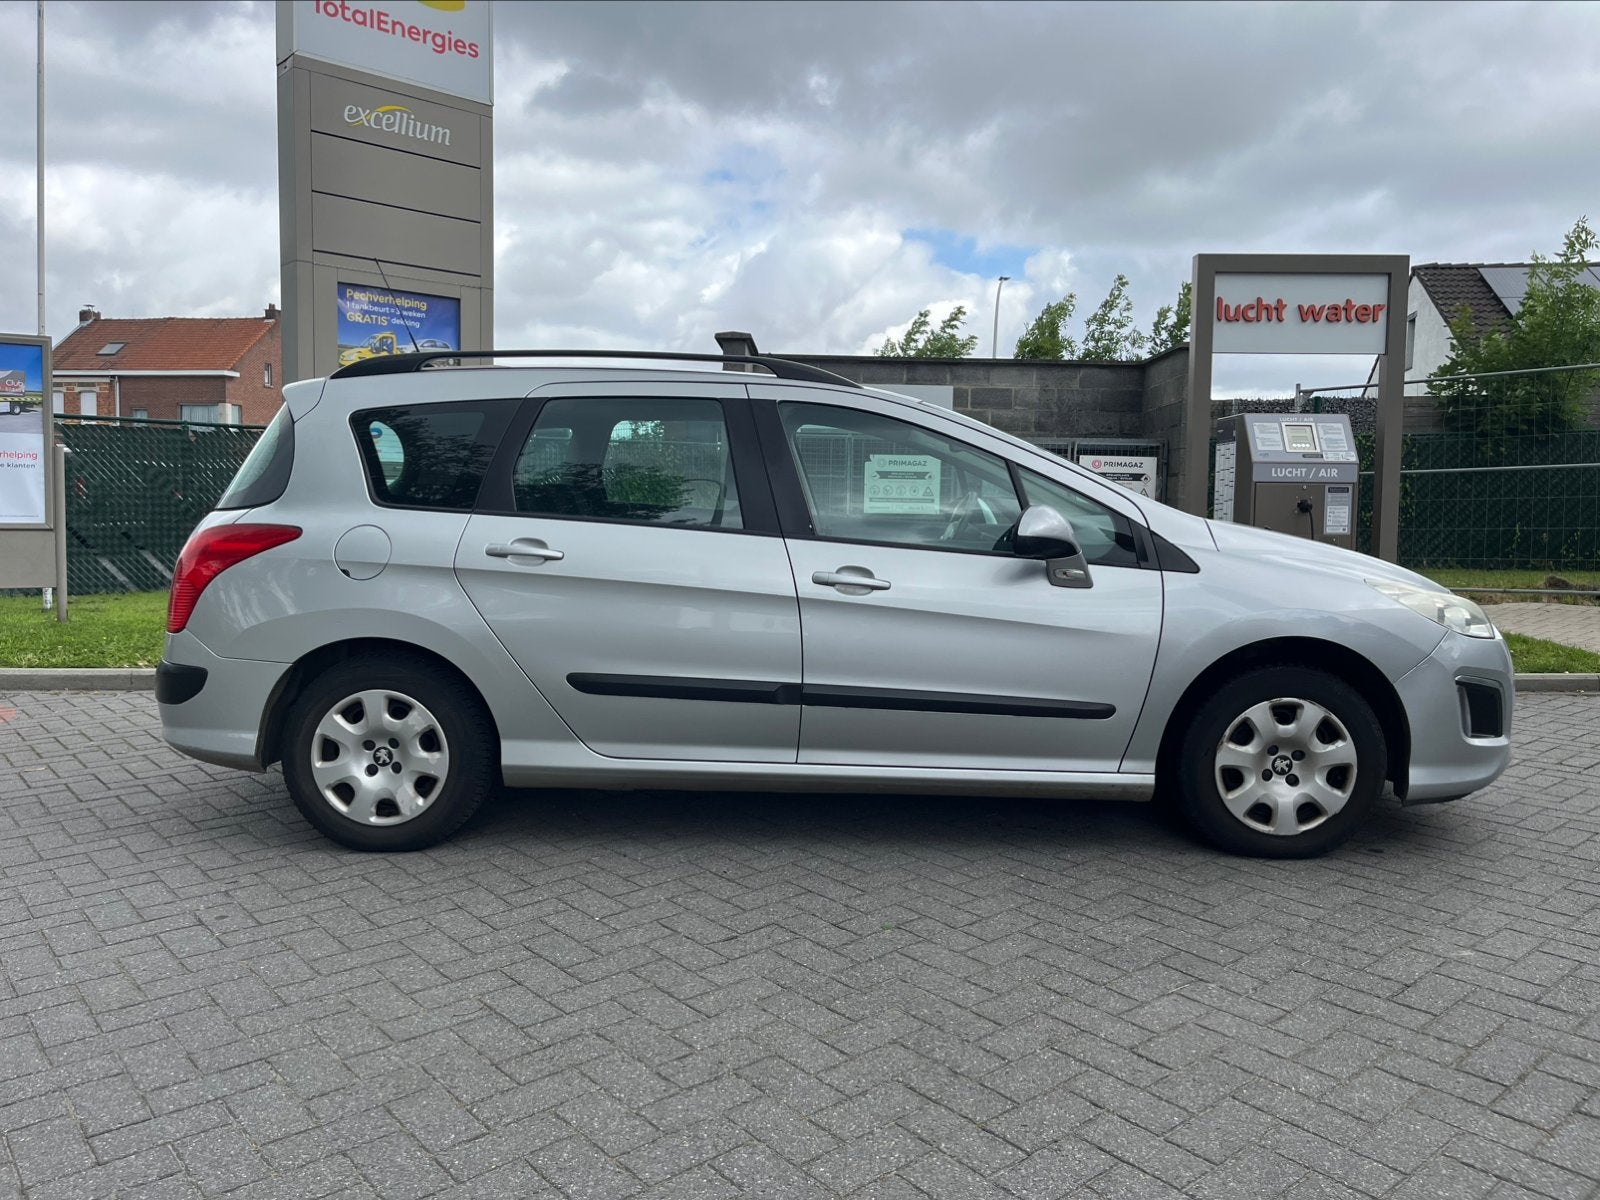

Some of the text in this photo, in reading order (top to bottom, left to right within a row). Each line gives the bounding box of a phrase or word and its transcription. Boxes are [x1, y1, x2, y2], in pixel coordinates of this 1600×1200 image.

[344, 104, 450, 145] excellium
[346, 288, 427, 311] Pechverhelping
[402, 310, 426, 318] weken
[1216, 296, 1386, 323] lucht water
[390, 317, 420, 329] dekking
[1271, 467, 1307, 477] LUCHT
[1318, 468, 1338, 477] AIR
